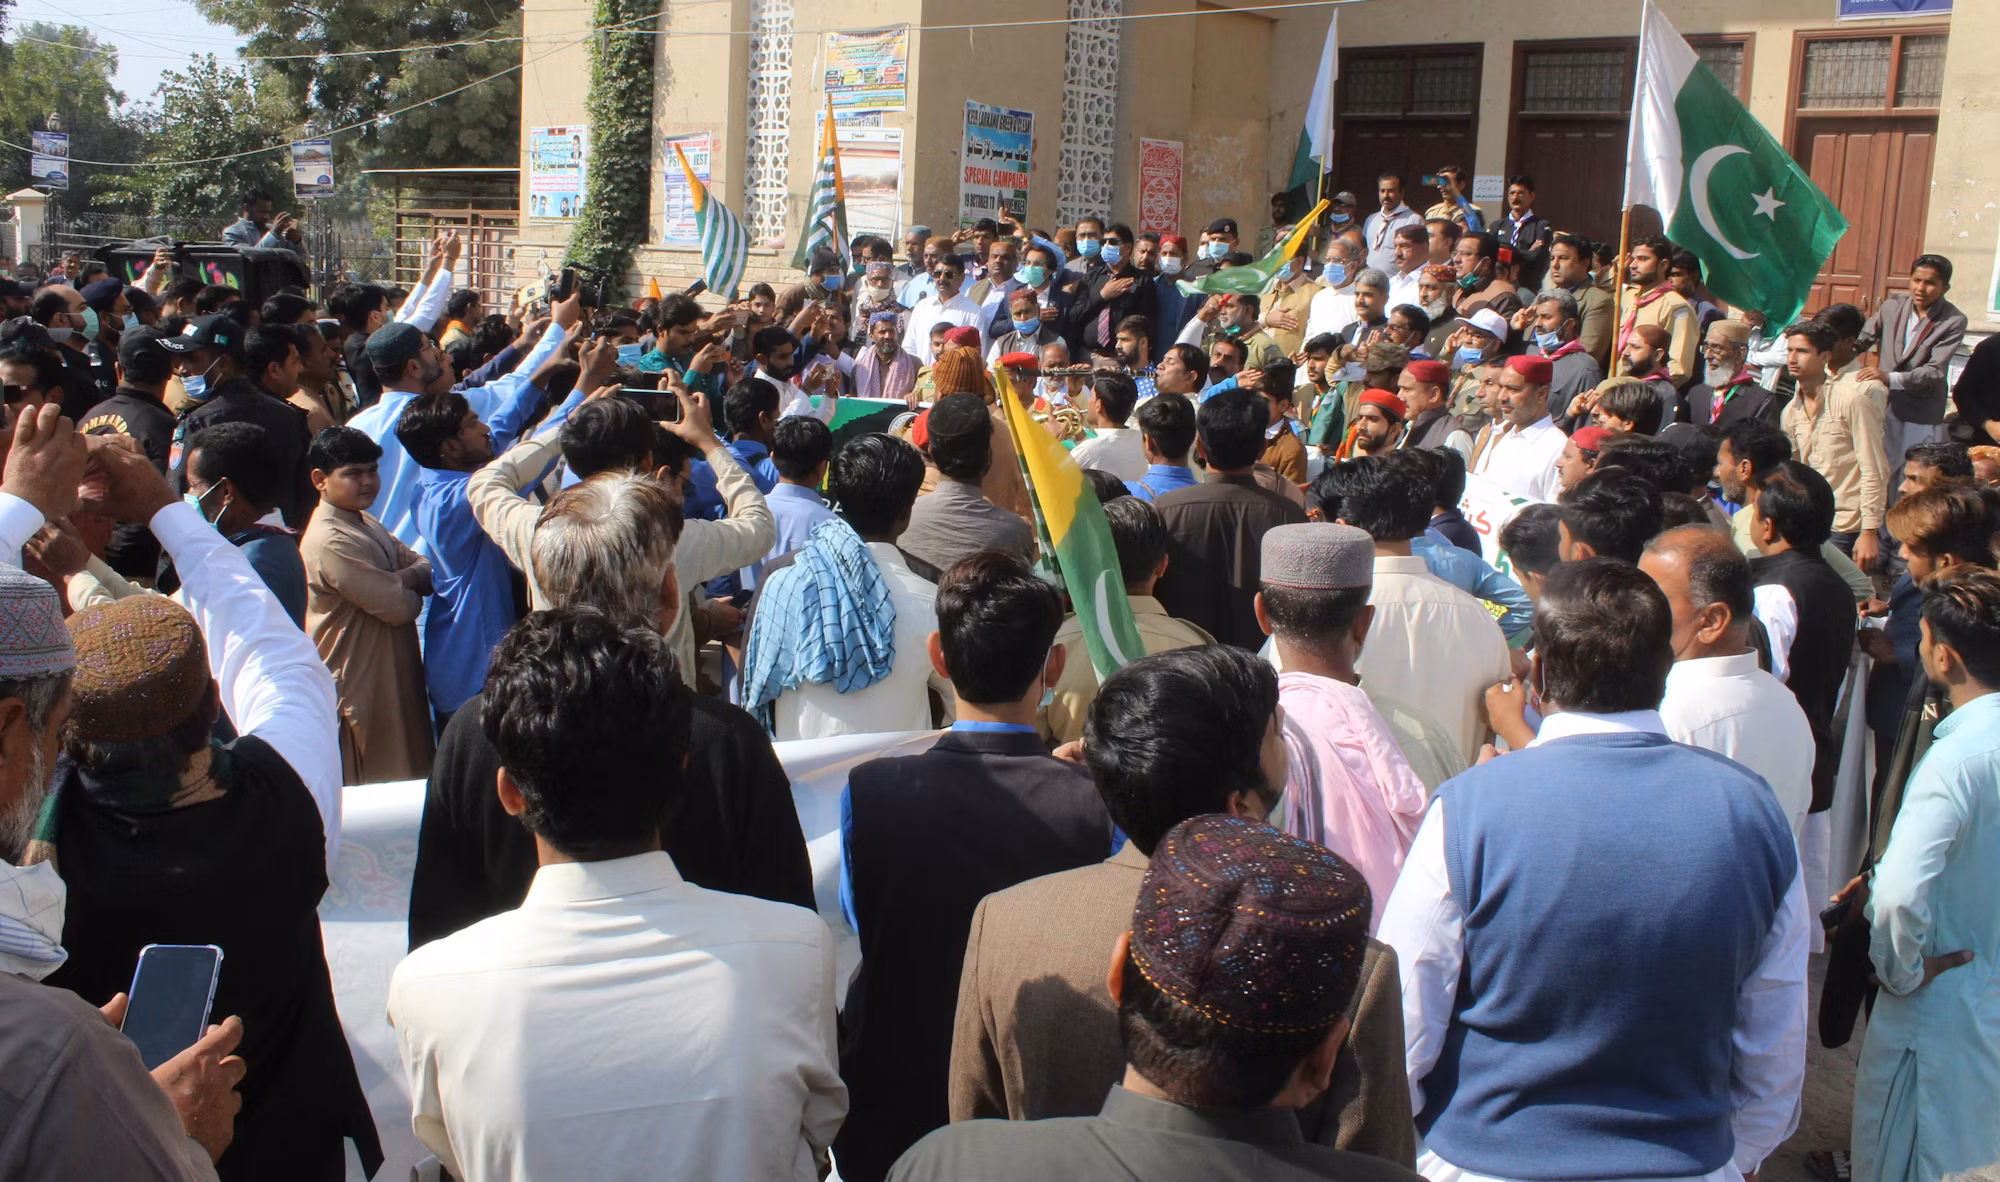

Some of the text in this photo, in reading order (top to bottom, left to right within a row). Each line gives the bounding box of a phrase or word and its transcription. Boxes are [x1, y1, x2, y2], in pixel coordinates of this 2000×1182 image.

[979, 111, 999, 129] LARKANO
[964, 166, 1028, 191] SPECIAL CAMPAIGN
[970, 193, 989, 210] OCTOBER
